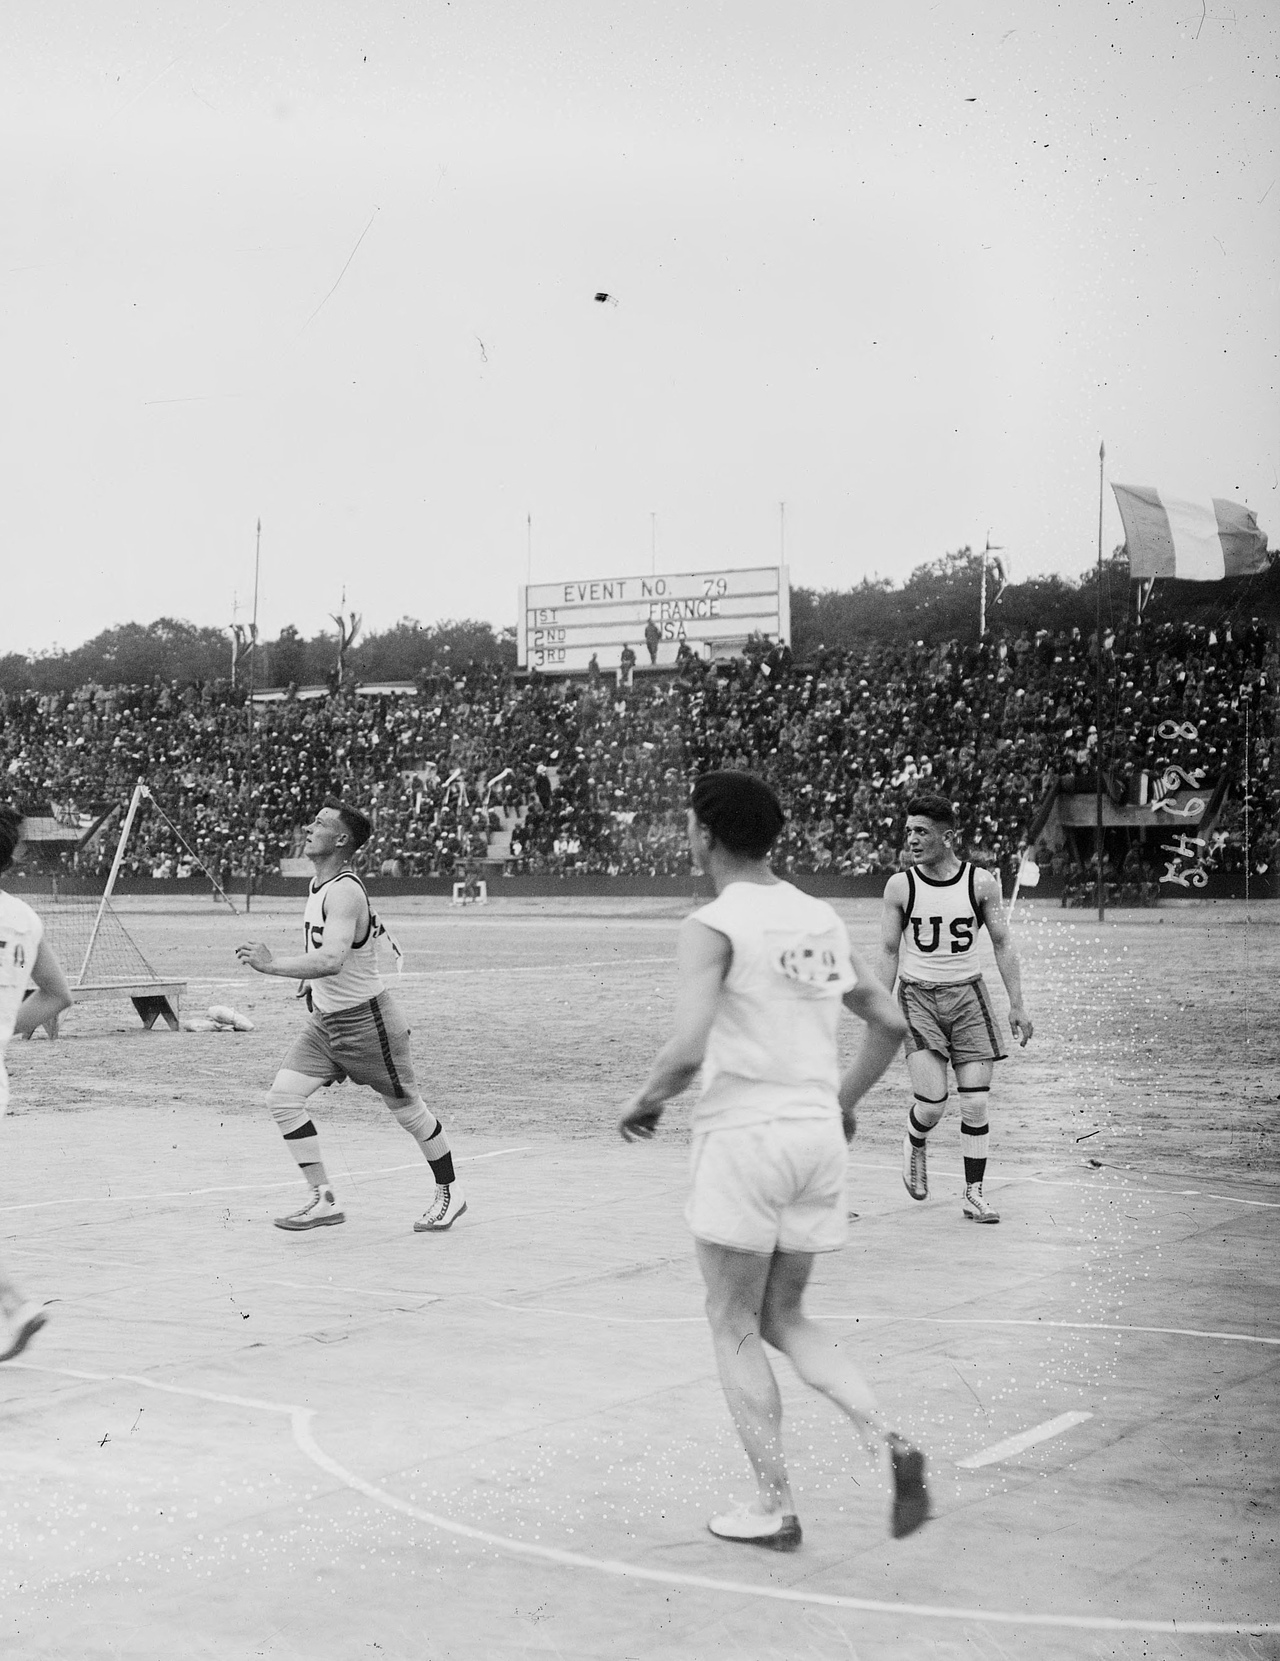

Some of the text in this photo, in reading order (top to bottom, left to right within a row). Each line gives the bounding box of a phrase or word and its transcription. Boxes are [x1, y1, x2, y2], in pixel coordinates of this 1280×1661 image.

[564, 582, 627, 602] EVENT
[704, 578, 727, 597] 79
[534, 599, 720, 628] 1ST FRANCE
[534, 629, 566, 647] 2ND
[534, 648, 566, 667] 3RD
[910, 916, 975, 954] US
